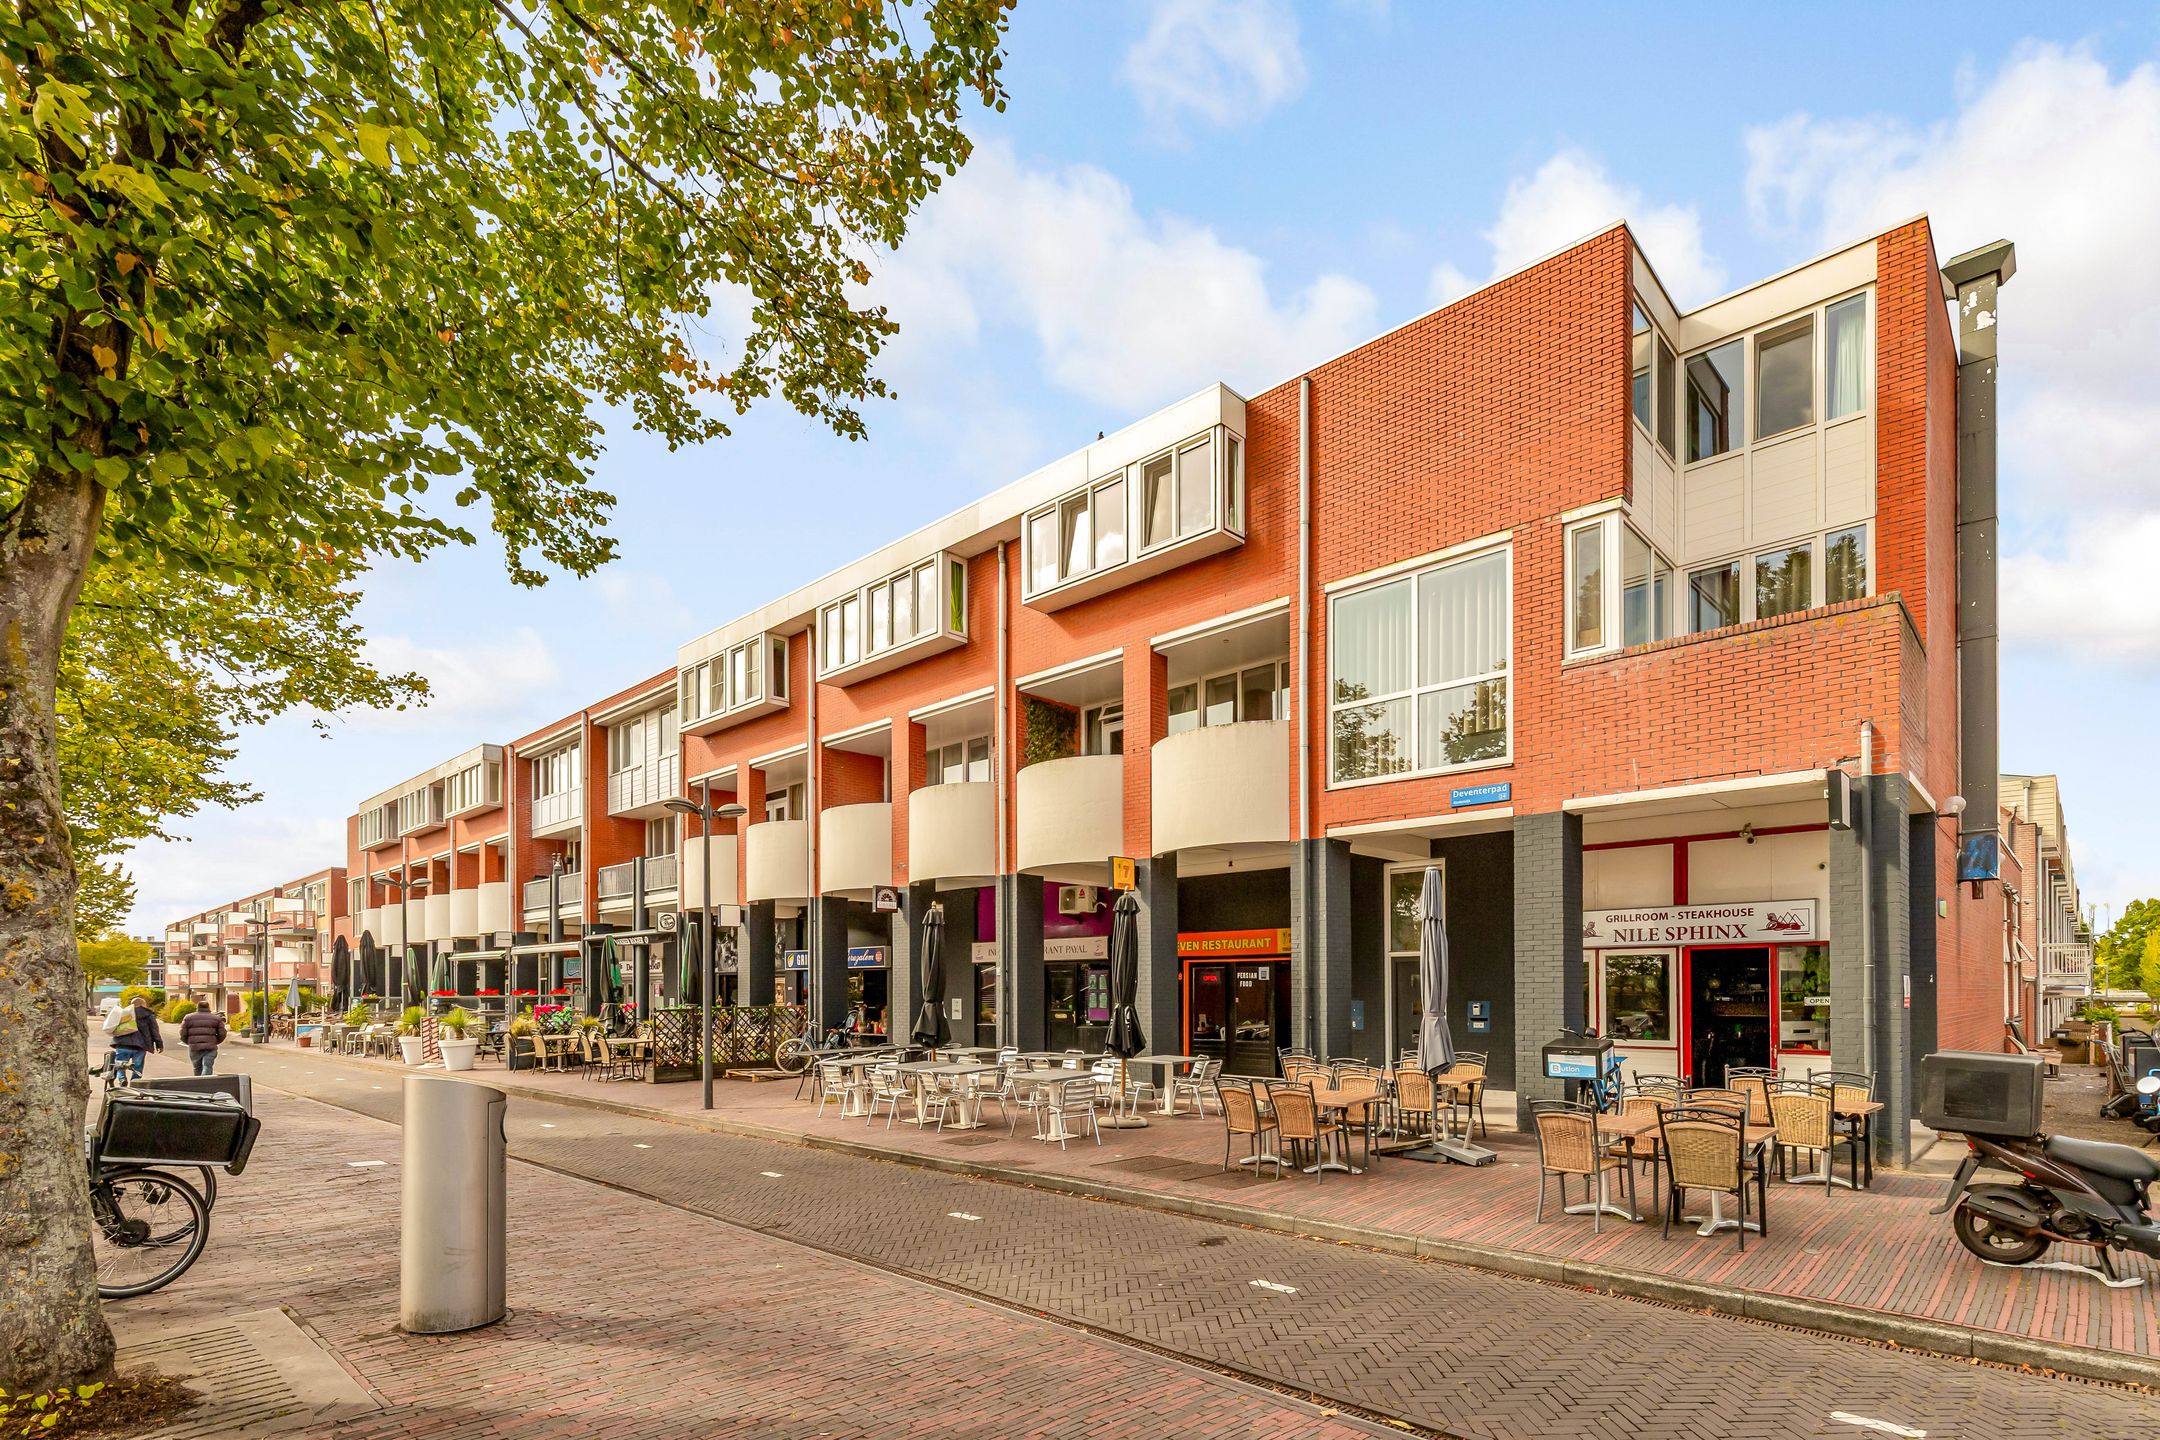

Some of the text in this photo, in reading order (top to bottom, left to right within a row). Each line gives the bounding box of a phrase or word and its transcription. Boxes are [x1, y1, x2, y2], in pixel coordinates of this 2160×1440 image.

[1453, 784, 1507, 798] Deventerpad
[1605, 911, 1669, 923] GRILLROOM
[1677, 907, 1755, 920] STEAKHOUSE
[1613, 923, 1749, 943] NILE SPHINX
[988, 948, 996, 956] IN
[1065, 944, 1088, 954] PAYAL
[1178, 941, 1200, 951] VEN
[1202, 937, 1271, 951] RESTAURANT
[796, 954, 808, 966] GRI
